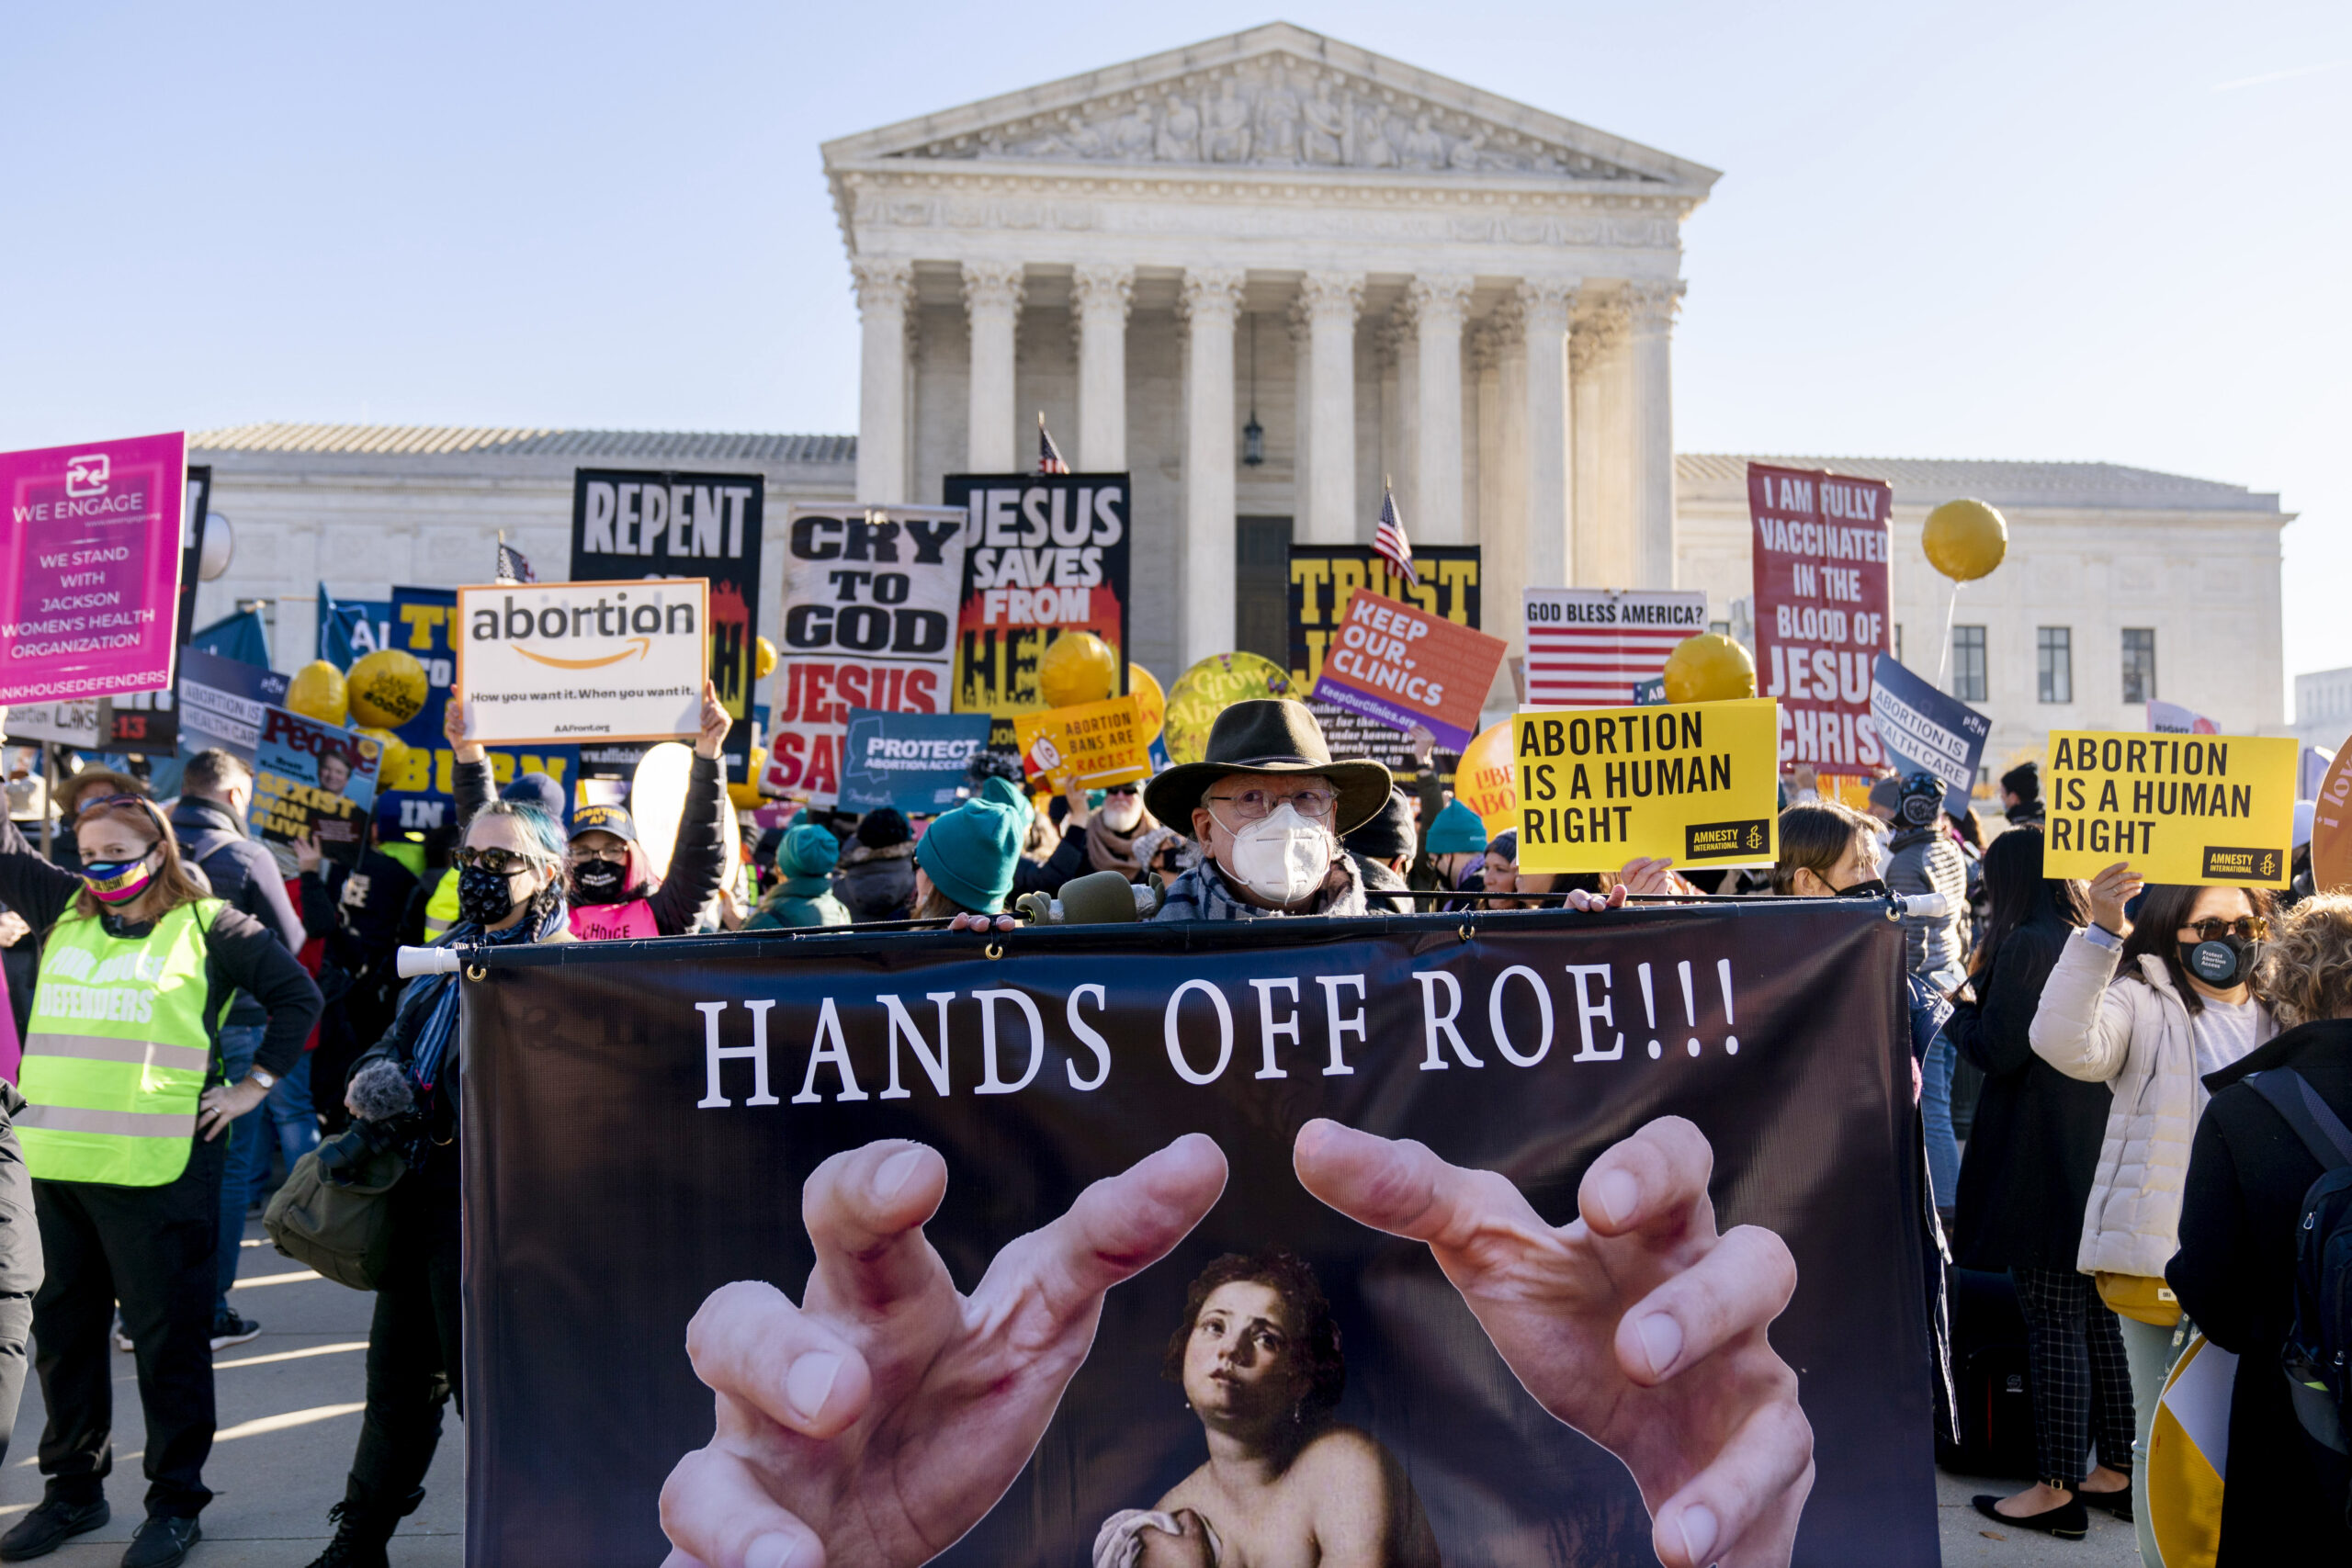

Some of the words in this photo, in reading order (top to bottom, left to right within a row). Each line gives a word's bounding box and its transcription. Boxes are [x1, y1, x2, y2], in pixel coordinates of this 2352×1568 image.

[13, 503, 49, 524] WE
[54, 492, 143, 519] ENGAGE
[966, 486, 1123, 548] JESUS
[1763, 476, 1774, 509] I
[1780, 478, 1813, 513] AM
[1819, 482, 1877, 521] FULLY
[583, 481, 752, 558] REPENT
[40, 553, 68, 569] WE
[72, 547, 129, 566] STAND
[790, 516, 961, 565] CRY
[1758, 517, 1888, 563] VACCINATED
[60, 571, 106, 588] WITH
[973, 547, 1102, 589] SAVES
[1792, 563, 1816, 598] IN
[1820, 567, 1862, 603] THE
[40, 592, 120, 613] JACKSON
[829, 570, 910, 604] TO
[1290, 558, 1477, 625] TRUST
[2, 615, 85, 637] WOMEN'S
[89, 608, 155, 629] HEALTH
[472, 592, 695, 641] abortion
[983, 587, 1091, 625] FROM
[1351, 599, 1429, 641] KEEP
[1527, 603, 1561, 622] GOD
[1567, 604, 1616, 623] BLESS
[1622, 604, 1703, 625] AMERICA?
[786, 604, 948, 653] GOD
[1777, 604, 1848, 643] BLOOD
[1854, 610, 1882, 646] OF
[11, 633, 141, 659] ORGANIZATION
[1343, 626, 1408, 666] OUR
[0, 671, 167, 699] NKHOUSEDEFENDERS
[1333, 649, 1444, 706] CLINICS
[1767, 645, 1880, 705] JESU
[185, 684, 244, 716] ABORTION
[470, 692, 499, 703] How
[502, 693, 526, 705] you
[529, 691, 561, 702] want
[564, 689, 578, 700] it.
[579, 687, 616, 699] When
[619, 690, 643, 701] you
[647, 687, 678, 697] want
[681, 685, 695, 696] it.
[782, 663, 937, 725] JESUS
[1320, 684, 1418, 728] KeepOurClinics.org
[186, 709, 229, 731] HEALTH
[232, 725, 256, 744] CAR
[554, 724, 611, 733] AAFront.org
[1065, 710, 1132, 735] ABORTION
[1362, 728, 1400, 740] heaven
[1520, 710, 1702, 758] ABORTION
[1781, 708, 1894, 767] CHRIS
[1875, 689, 1945, 746] ABORTION
[1947, 738, 1964, 758] IS
[866, 737, 980, 760] PROTECT
[1069, 737, 1104, 755] BANS
[1109, 729, 1135, 747] ARE
[1874, 714, 1919, 758] HEALTH
[1922, 750, 1965, 785] CARE
[2053, 738, 2228, 776] ABORTION
[865, 758, 927, 771] ABORTION
[927, 759, 968, 771] ACCES
[1077, 749, 1142, 773] RACIST.
[1523, 764, 1556, 801] IS
[1570, 763, 1592, 800] A
[1605, 753, 1731, 798] HUMAN
[253, 793, 308, 823] MAN
[256, 772, 356, 819] SEXIST
[399, 799, 445, 829] IN
[2054, 778, 2086, 812] IS
[2098, 779, 2120, 813] A
[2132, 781, 2252, 818] HUMAN
[1523, 806, 1633, 844] RIGHT
[1693, 829, 1739, 843] AMNESTY
[2052, 818, 2156, 855] RIGHT
[1693, 840, 1739, 852] INTERNATIONAL
[2210, 853, 2254, 866] AMNESTY
[2210, 864, 2252, 874] INTERNATIONAL
[2200, 960, 2221, 969] Access
[2201, 955, 2227, 964] Abortion
[2202, 949, 2223, 959] Protect
[39, 983, 155, 1024] DEFENDERS
[695, 982, 1112, 1110] HANDS
[1163, 974, 1367, 1086] OFF
[1411, 958, 1739, 1071] ROE!!!
